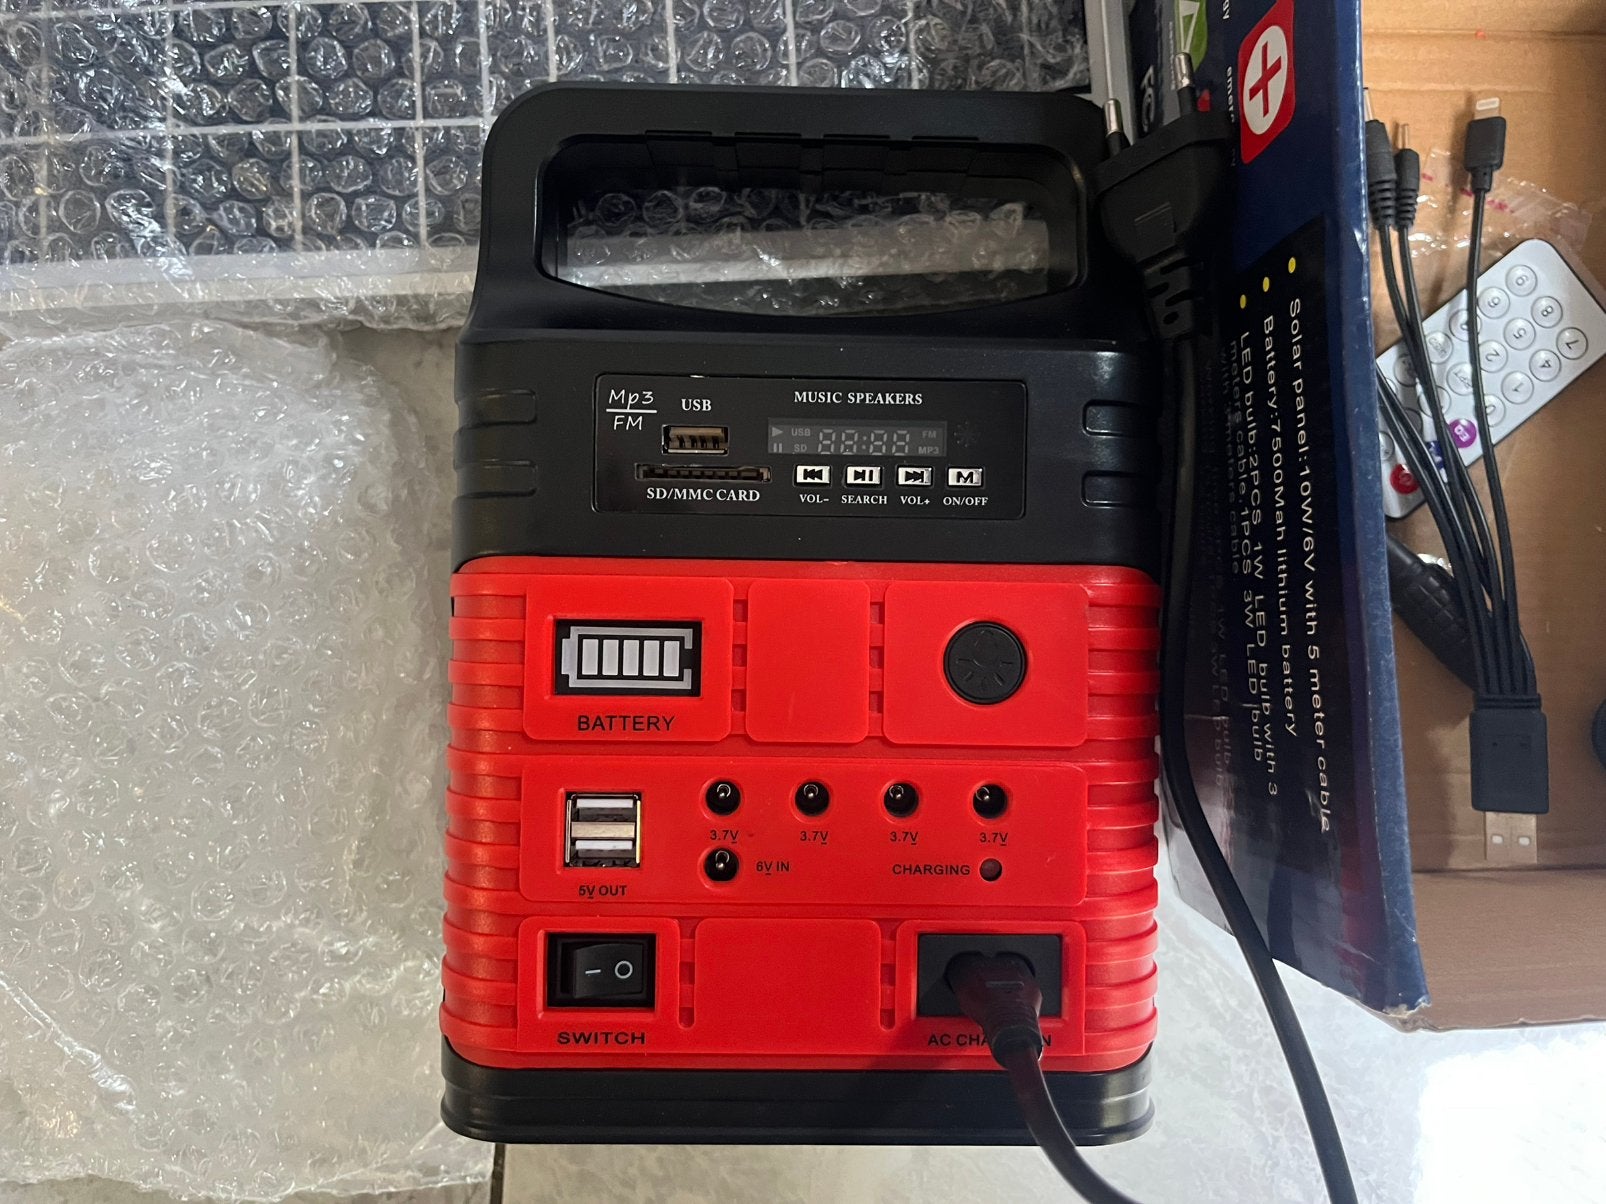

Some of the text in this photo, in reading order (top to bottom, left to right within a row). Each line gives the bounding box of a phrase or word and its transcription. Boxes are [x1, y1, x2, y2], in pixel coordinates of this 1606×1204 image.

[1540, 305, 1555, 318] 8
[1288, 298, 1302, 376] Solar
[1512, 326, 1527, 340] 5
[1565, 338, 1580, 350] 7
[1240, 332, 1253, 384] LED
[1484, 350, 1500, 362] 2
[1540, 359, 1553, 370] 4
[608, 389, 655, 413] Mp3
[681, 398, 712, 411] USB
[794, 391, 923, 405] MUSIC SPEAKERS
[613, 415, 643, 430] FM
[791, 428, 811, 437] USB
[922, 430, 936, 439] FM
[1454, 423, 1470, 442] EQ
[794, 443, 808, 452] SD
[918, 446, 939, 454] MP3
[955, 471, 976, 484] M
[646, 487, 760, 501] SD/MMC CARD
[841, 494, 888, 505] SEARCH
[900, 495, 930, 505] VOL+
[943, 495, 988, 506] ON/OFF
[1253, 543, 1265, 579] 1W
[1277, 549, 1293, 635] lithium
[1243, 590, 1254, 628] 3W
[1303, 580, 1319, 635] with
[1254, 595, 1267, 647] LED
[1307, 645, 1320, 659] 5
[1246, 643, 1258, 694] LED
[1258, 663, 1273, 714] bulb
[1281, 644, 1298, 737] battery
[1309, 669, 1327, 749] meter
[577, 715, 675, 731] BATTERY
[1251, 709, 1263, 761] bulb
[1264, 723, 1277, 773] with
[1268, 782, 1279, 796] 3
[1317, 756, 1331, 832] cable
[709, 829, 739, 844] 3.7V
[799, 830, 829, 845] 3.7V
[889, 830, 919, 845] 3.7V
[979, 831, 1009, 846] 3.7V
[755, 861, 790, 875] 6V IN
[891, 863, 970, 877] CHARGING
[578, 884, 628, 898] 5V OUT
[557, 1031, 646, 1045] SWITCH
[928, 1034, 952, 1046] AC
